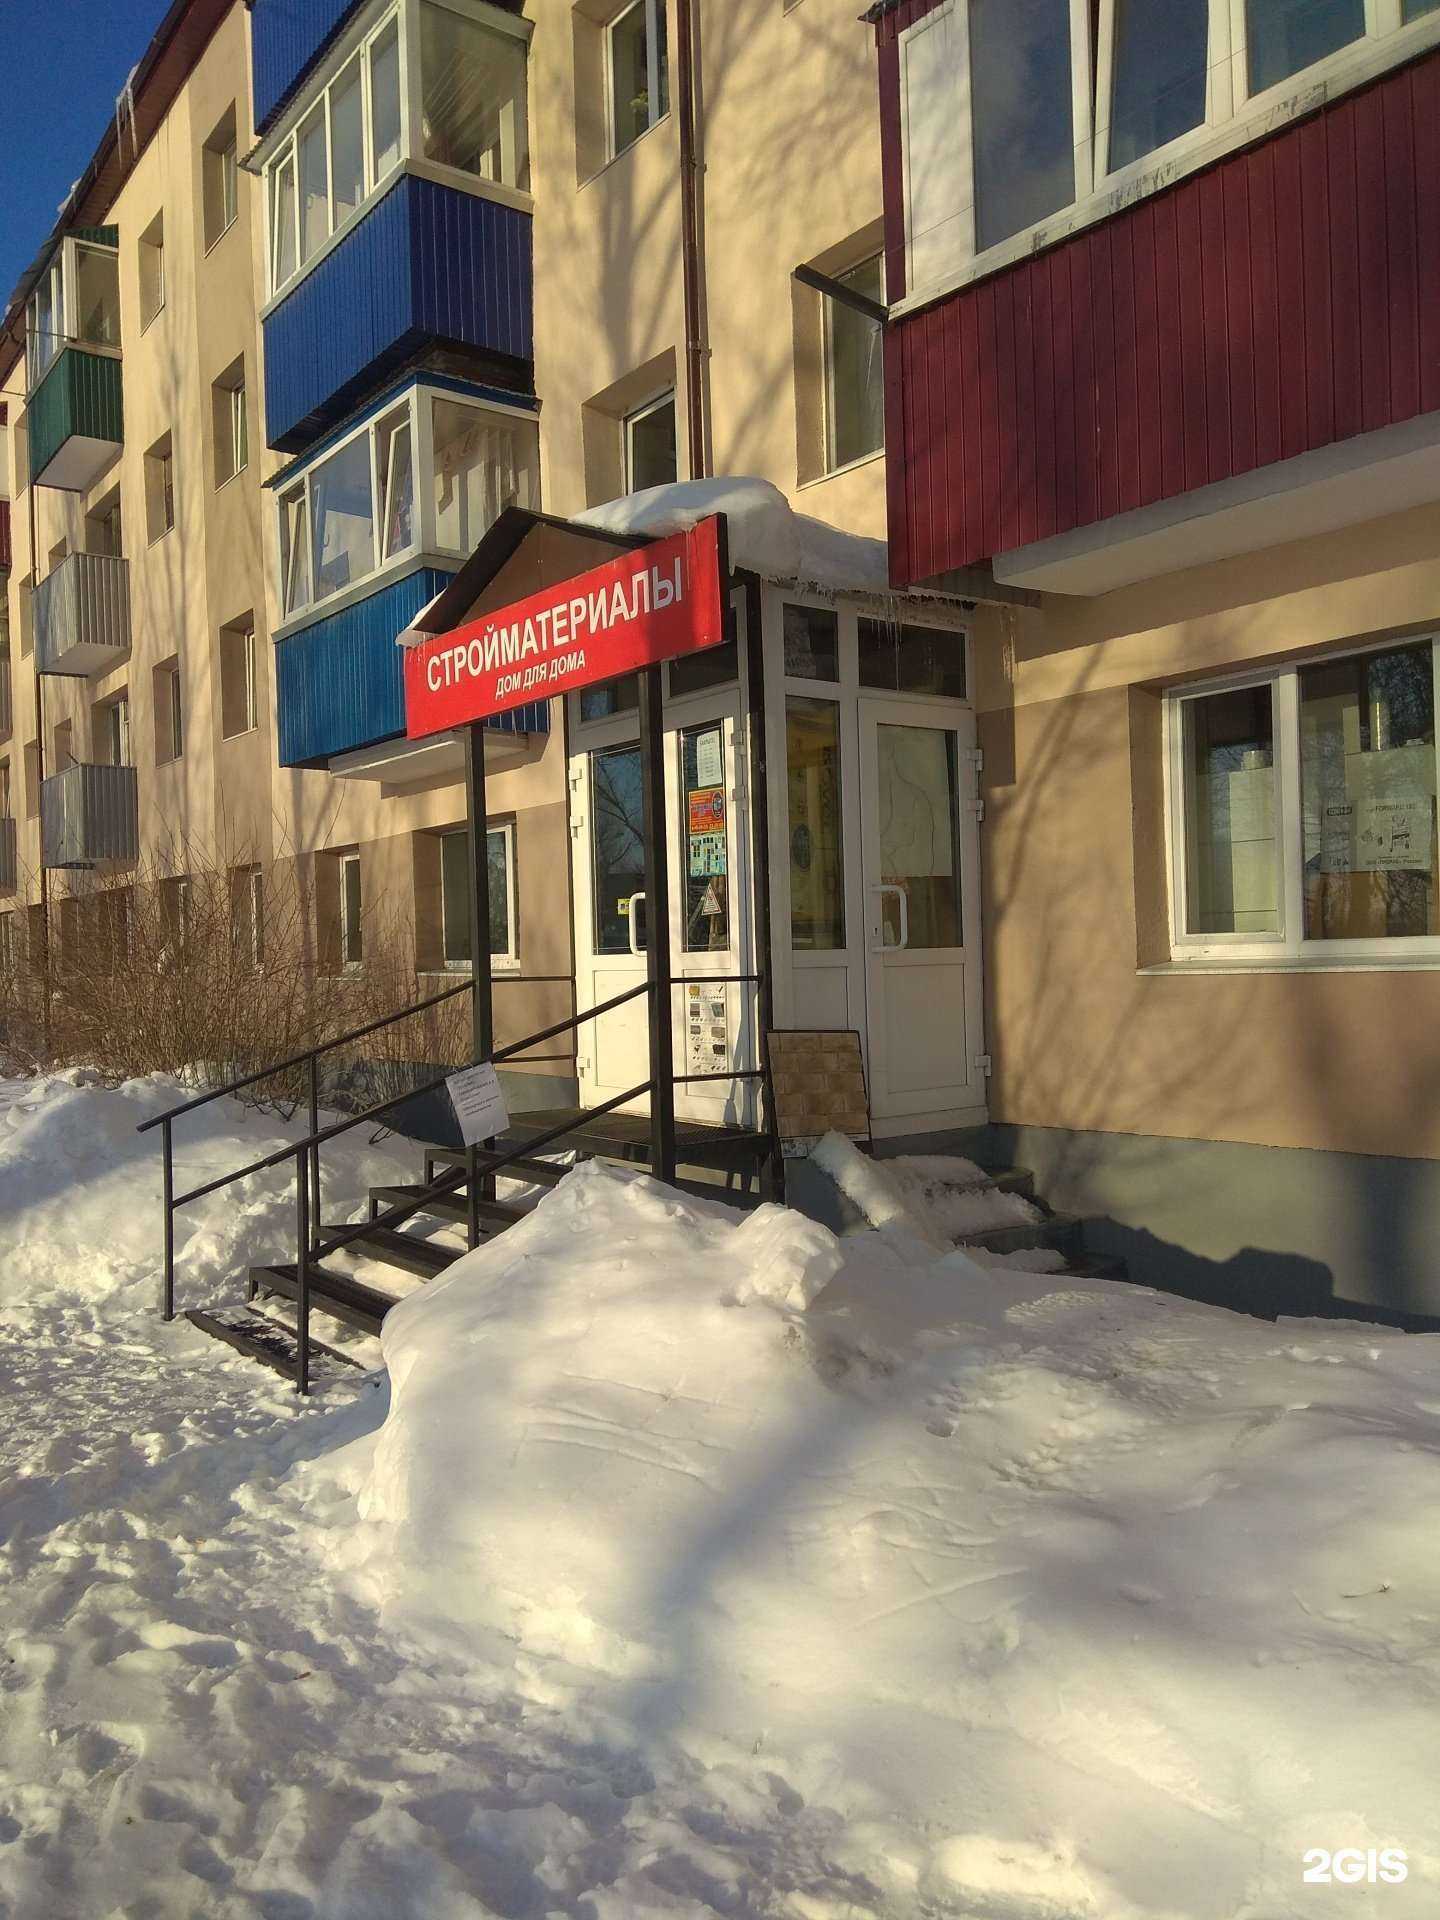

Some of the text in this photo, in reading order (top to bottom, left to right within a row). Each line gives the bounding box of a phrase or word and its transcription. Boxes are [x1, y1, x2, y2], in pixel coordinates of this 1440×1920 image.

[426, 556, 683, 692] СТРОЙМАТЕРИАЛЫ
[495, 649, 586, 701] ДОМ ДЛЯ ДОМА
